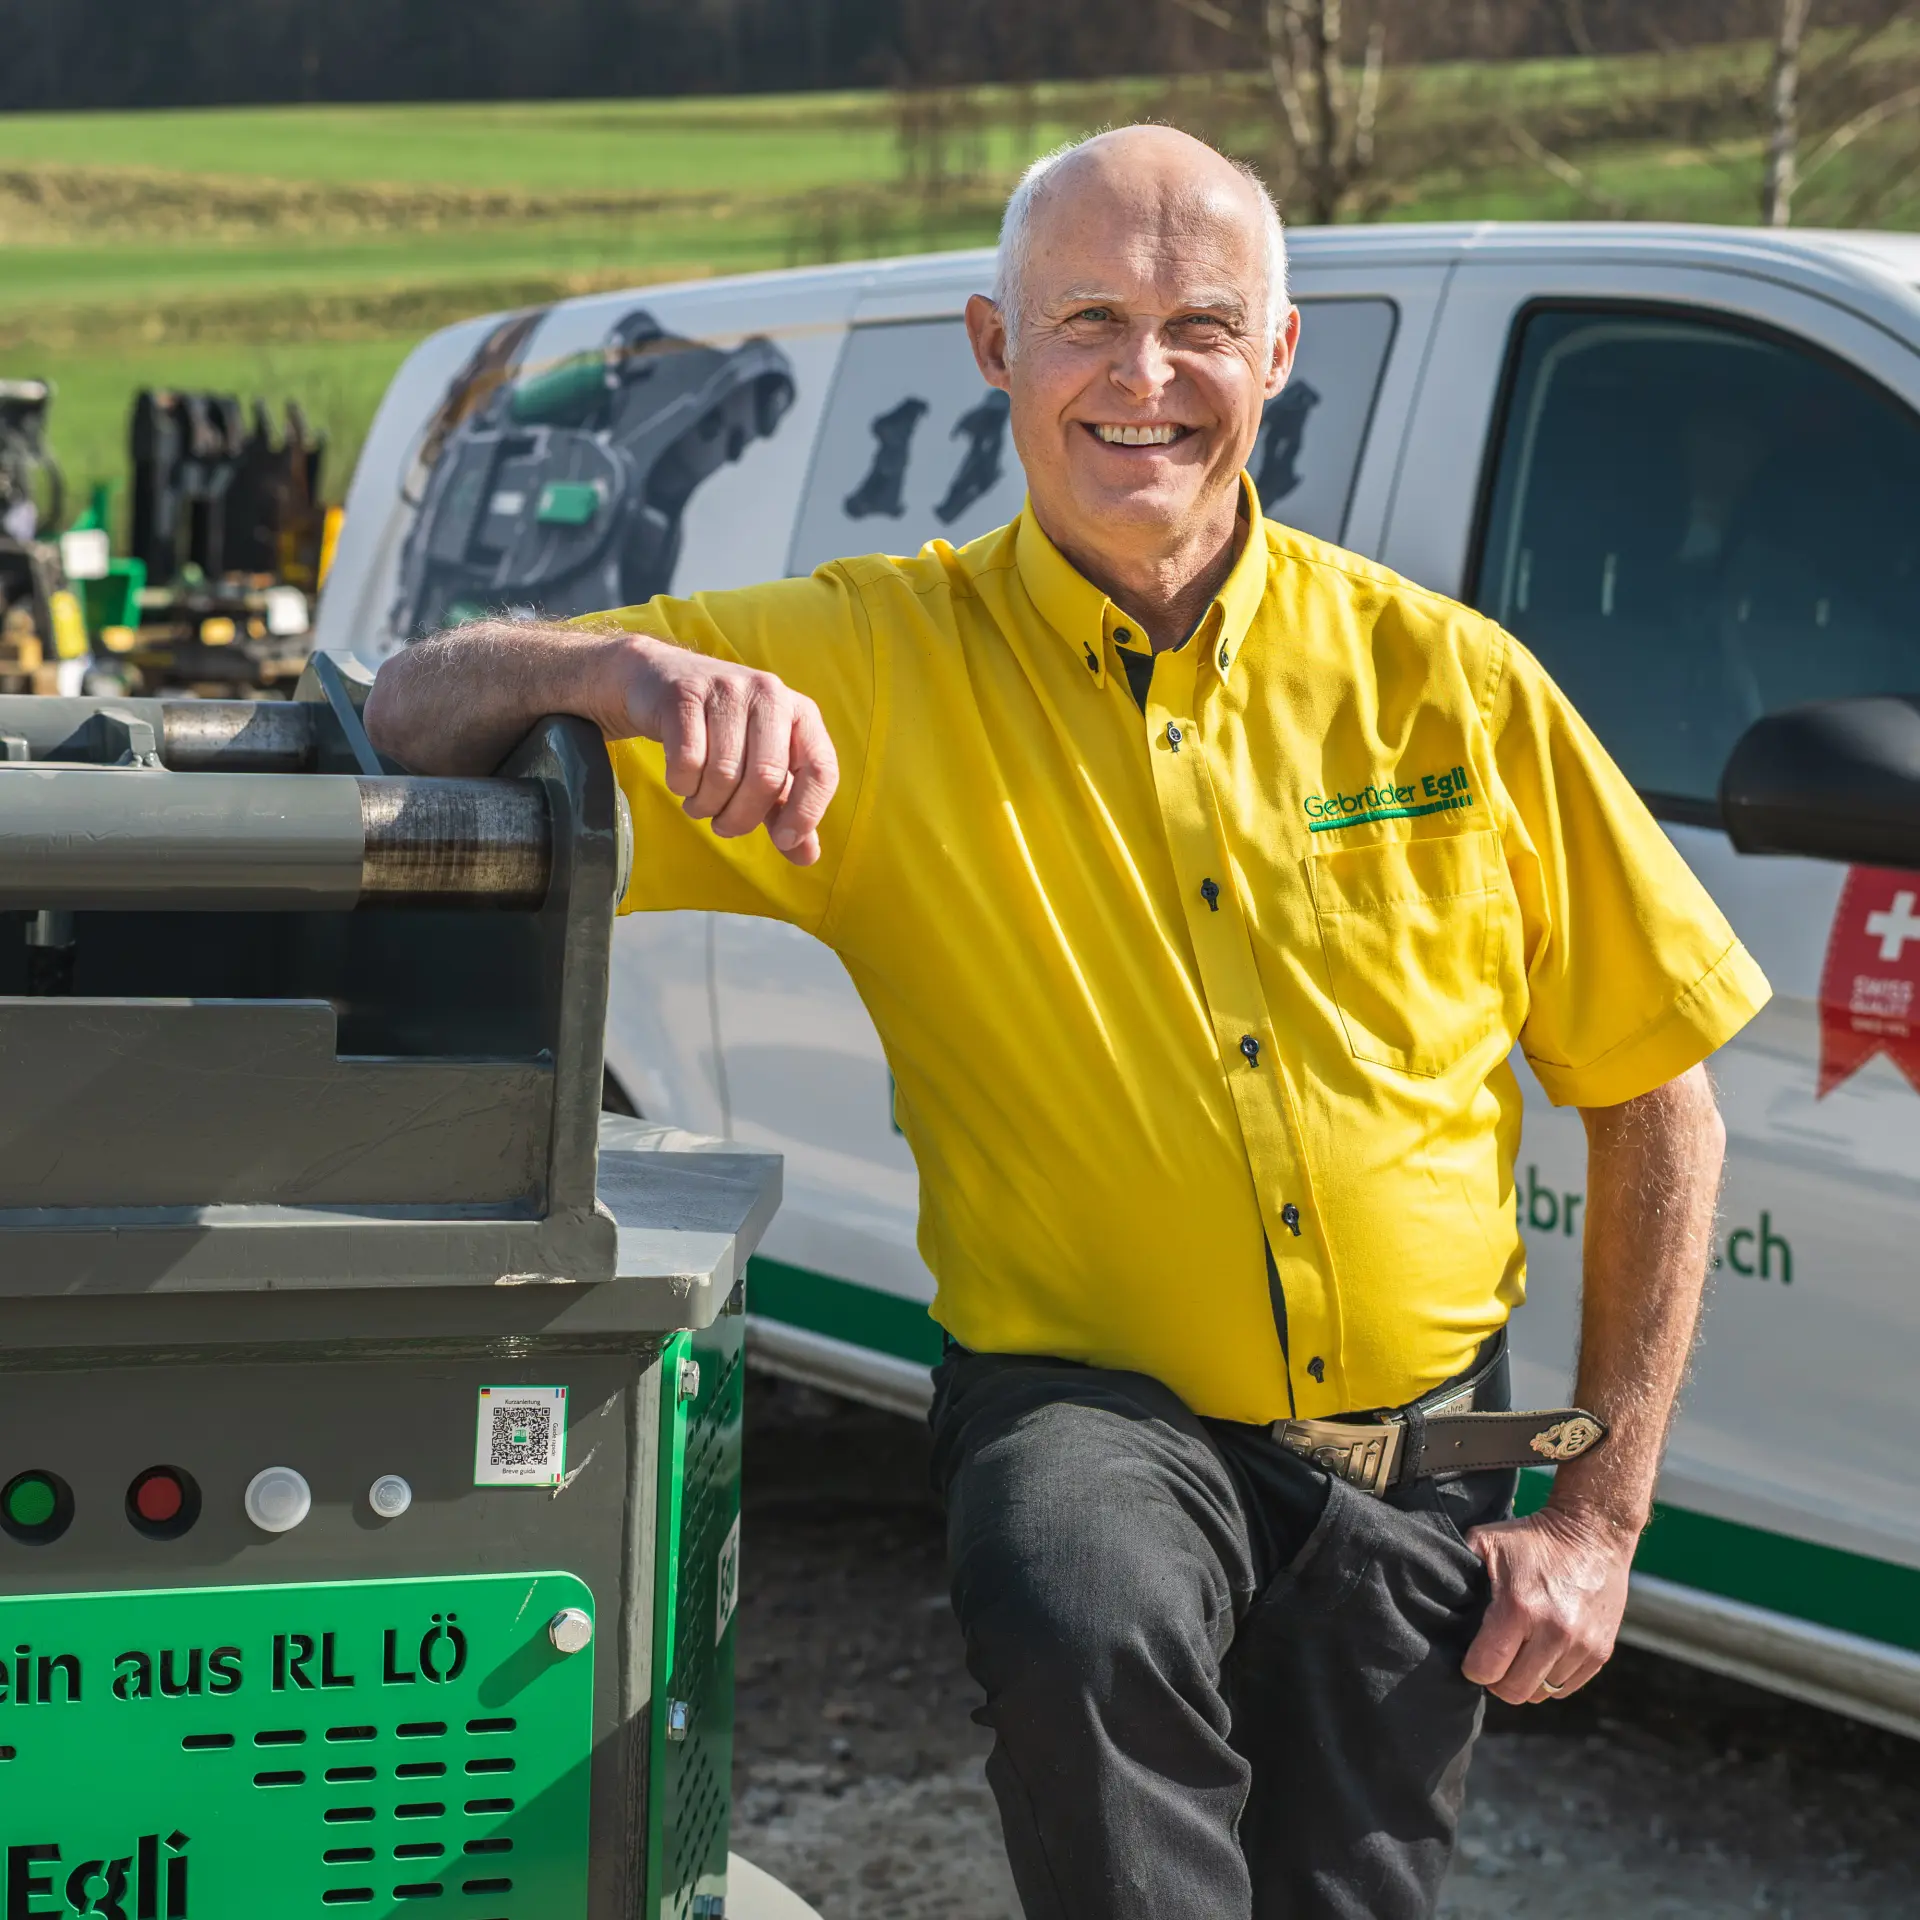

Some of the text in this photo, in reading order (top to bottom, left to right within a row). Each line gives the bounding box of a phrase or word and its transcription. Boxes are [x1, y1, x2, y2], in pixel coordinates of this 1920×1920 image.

[1304, 765, 1469, 818] Gebrüder Egli
[520, 1468, 536, 1476] guida
[112, 1646, 243, 1702] aus
[271, 1632, 355, 1693] RL
[382, 1612, 468, 1687] LÖ
[6, 1829, 191, 1920] Egli
